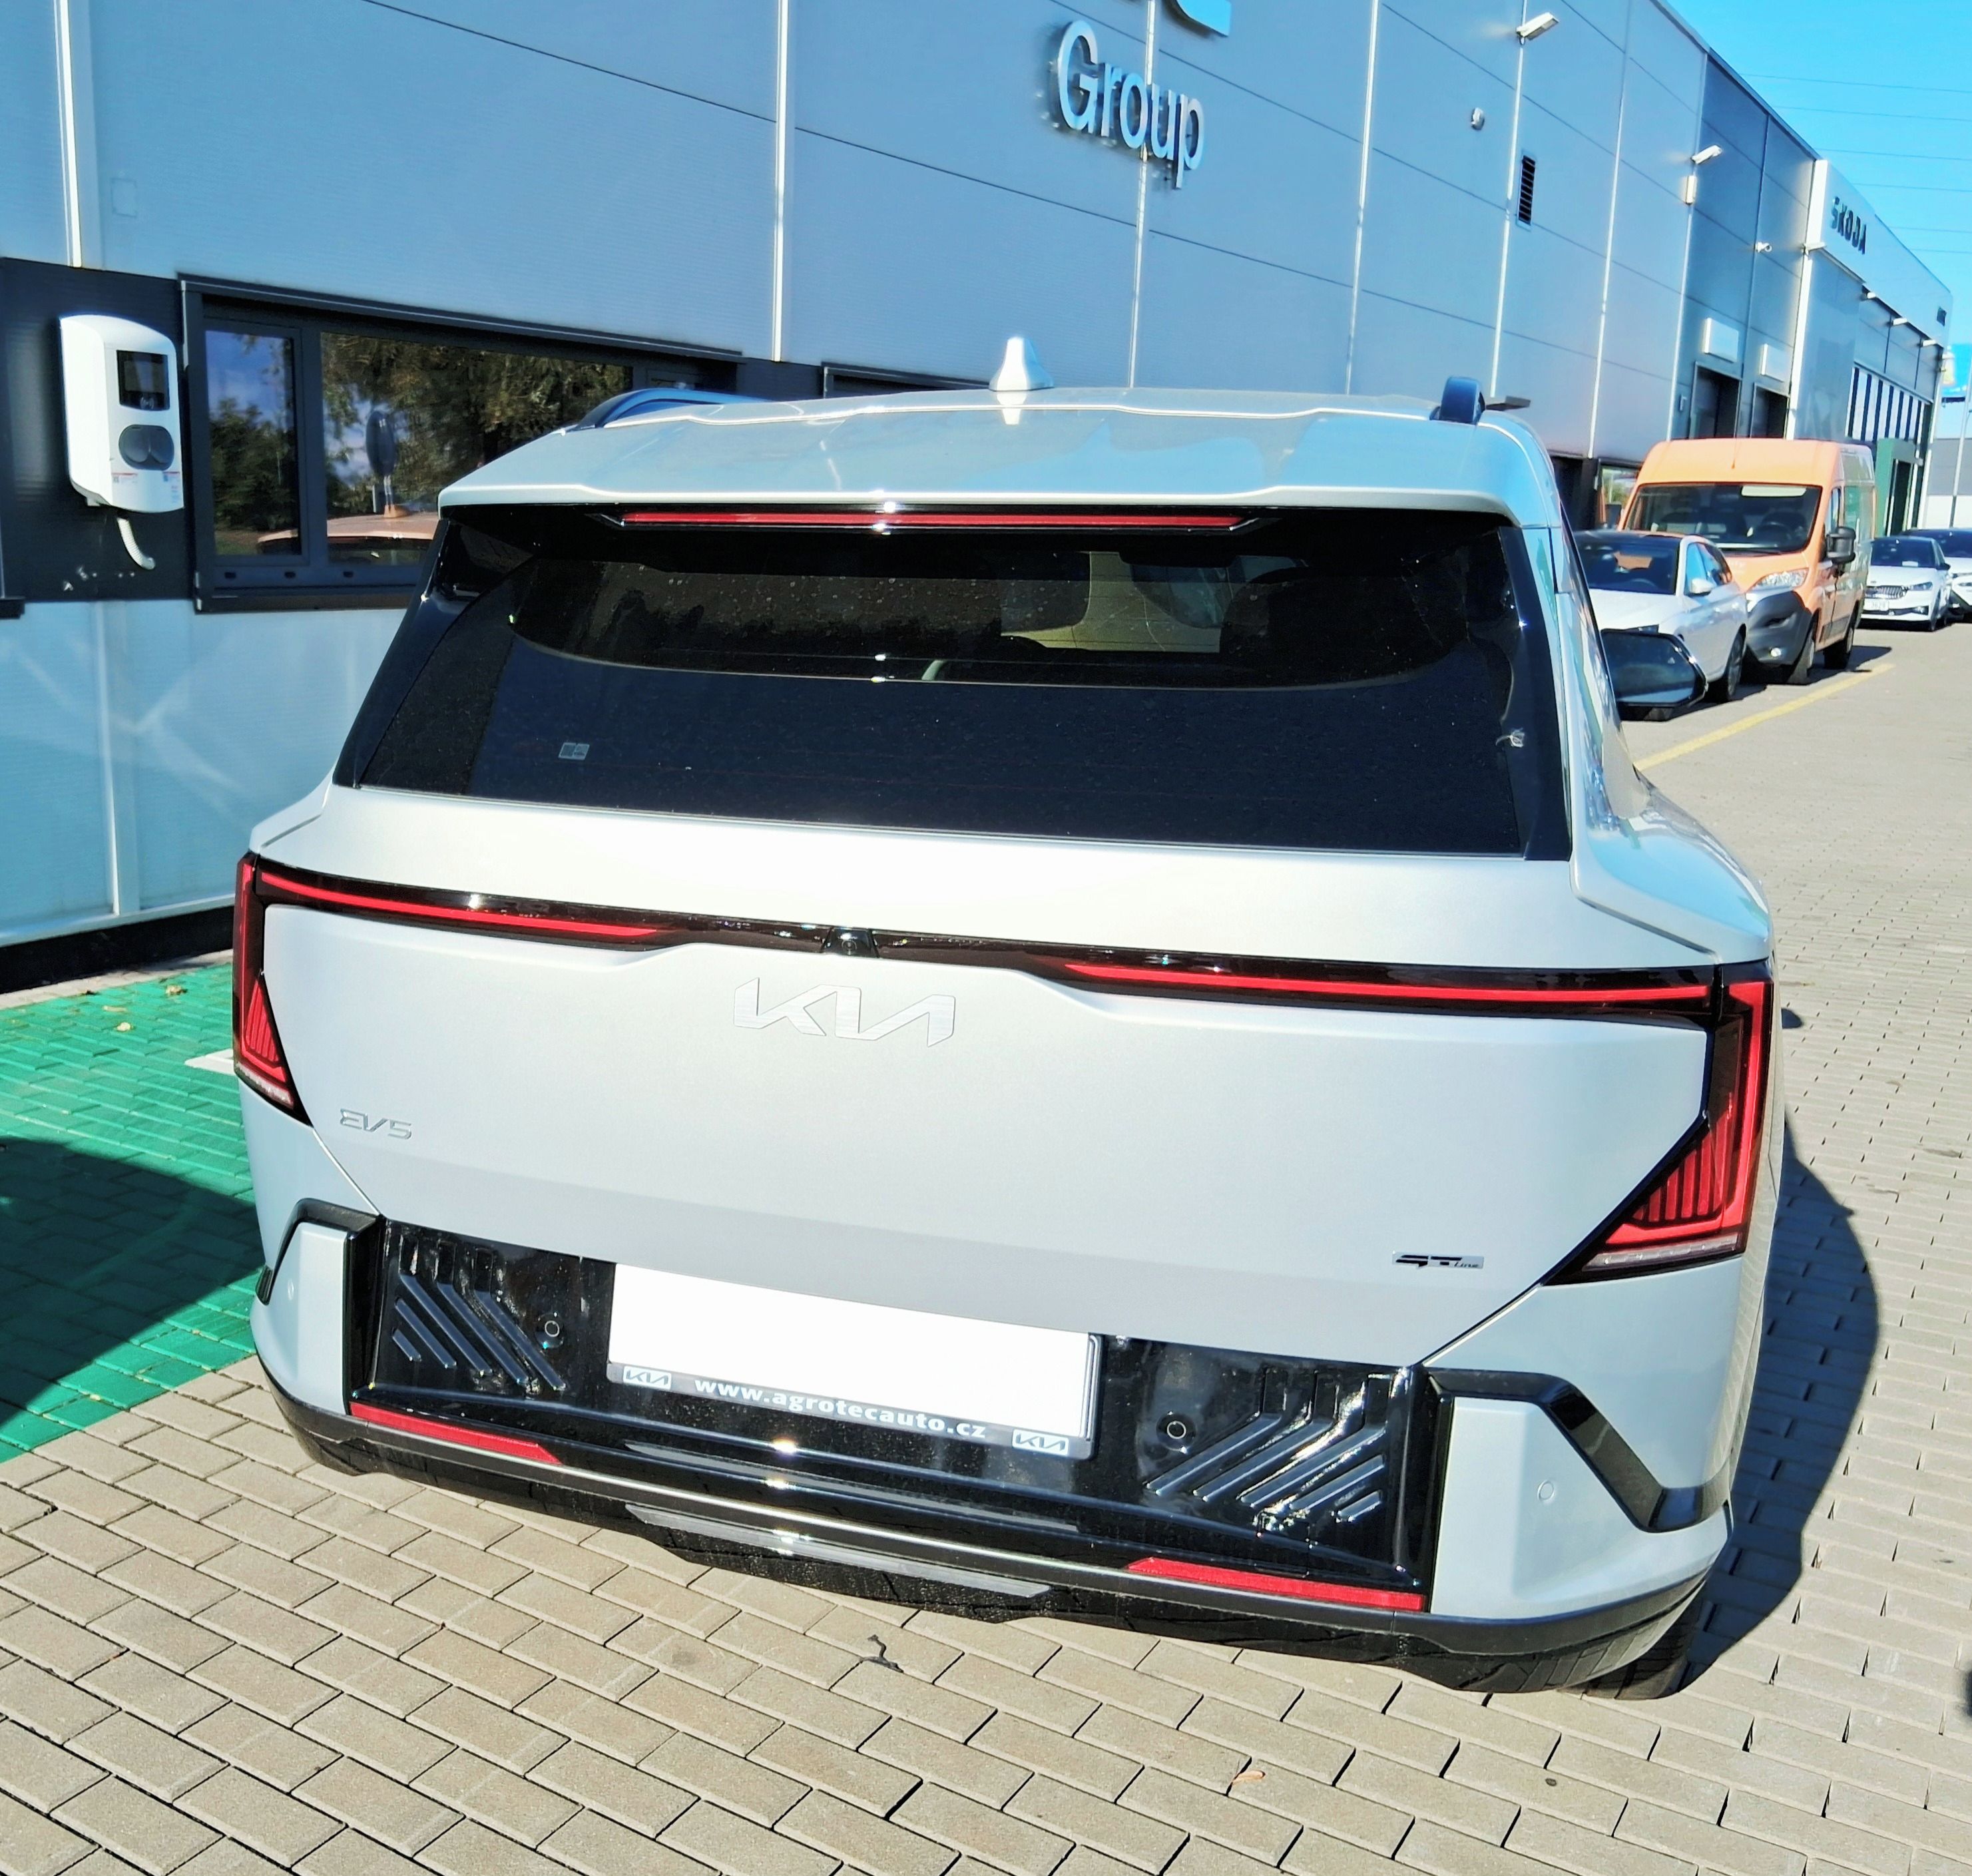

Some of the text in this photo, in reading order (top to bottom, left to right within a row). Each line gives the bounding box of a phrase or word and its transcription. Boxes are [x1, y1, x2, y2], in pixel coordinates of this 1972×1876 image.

[1057, 20, 1204, 189] Group
[733, 977, 956, 1048] KIA
[340, 1108, 412, 1140] EV5
[626, 1369, 669, 1386] KIA
[694, 1379, 986, 1439] www.agrotecauto.cz
[1015, 1433, 1066, 1452] KIA
